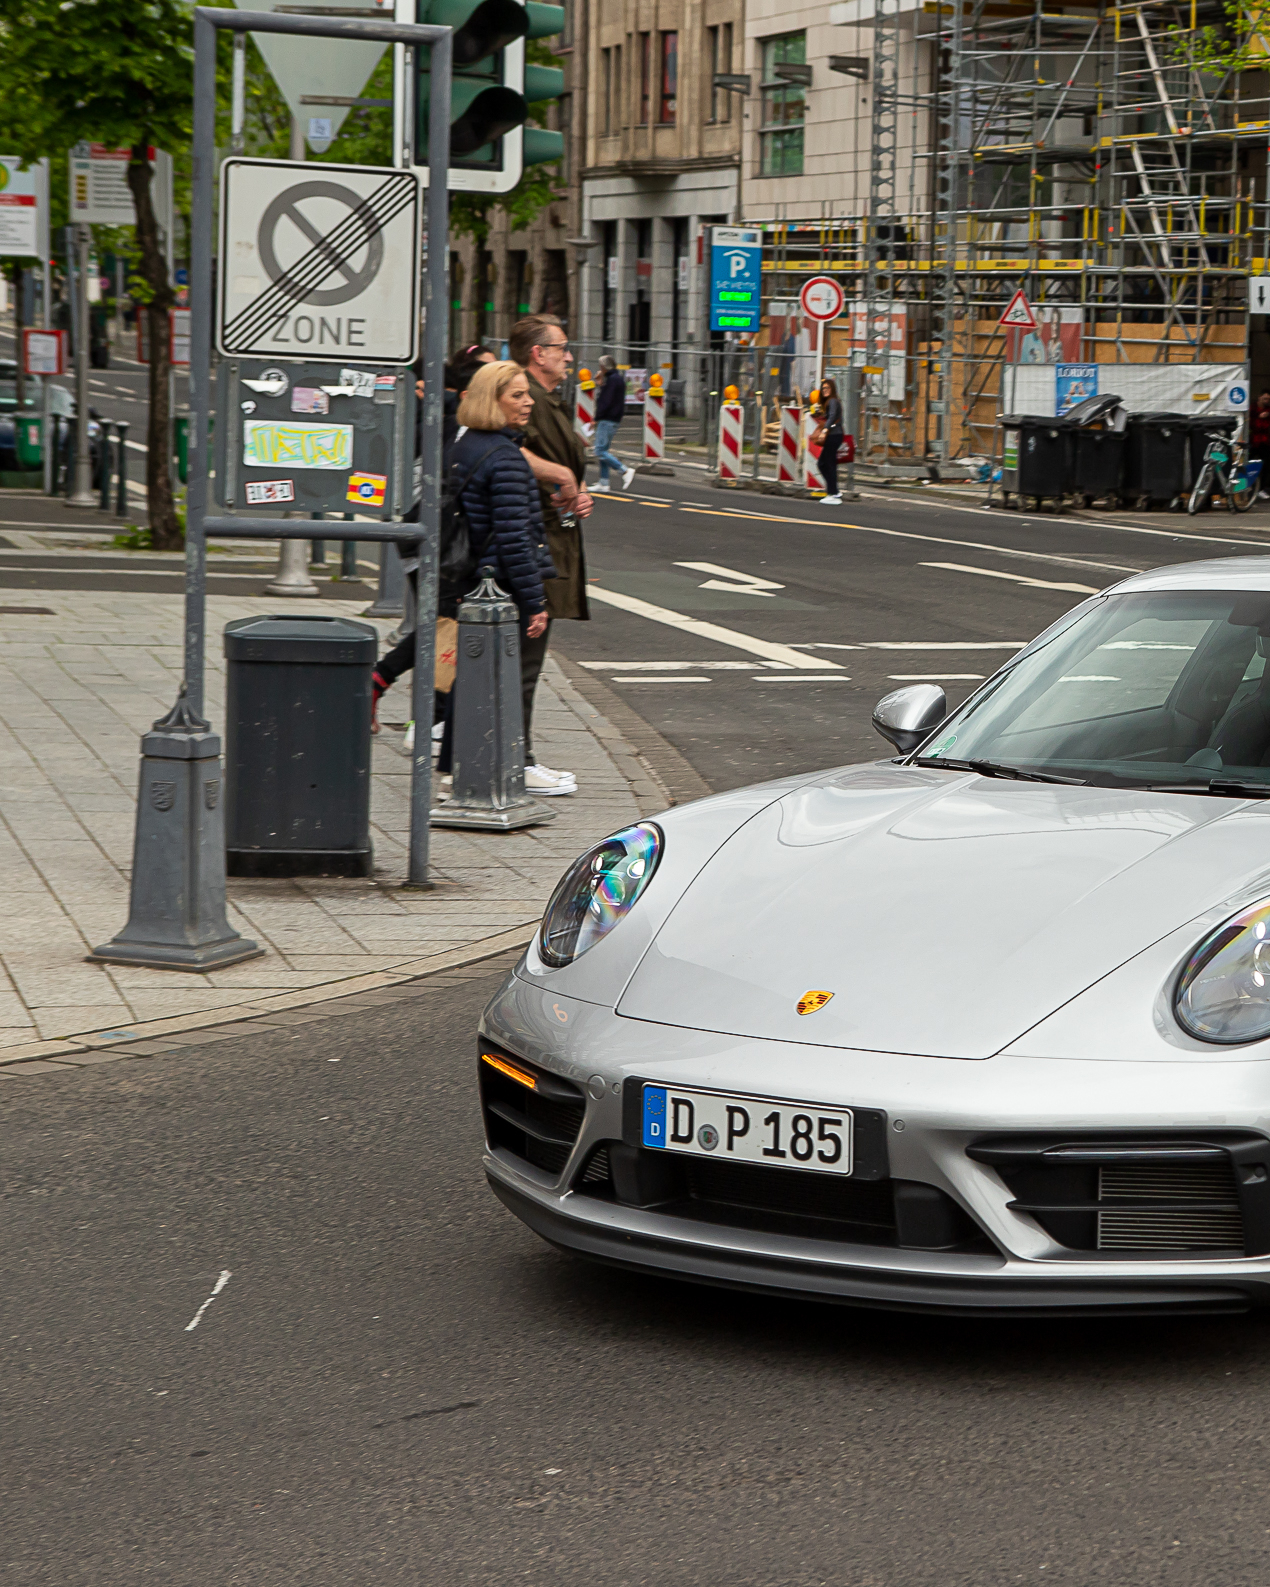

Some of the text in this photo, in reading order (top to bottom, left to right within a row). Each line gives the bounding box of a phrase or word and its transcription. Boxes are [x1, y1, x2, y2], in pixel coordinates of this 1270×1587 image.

[730, 256, 746, 278] P
[271, 314, 367, 346] ZONE
[651, 1122, 660, 1136] D
[670, 1096, 843, 1164] D P 185
